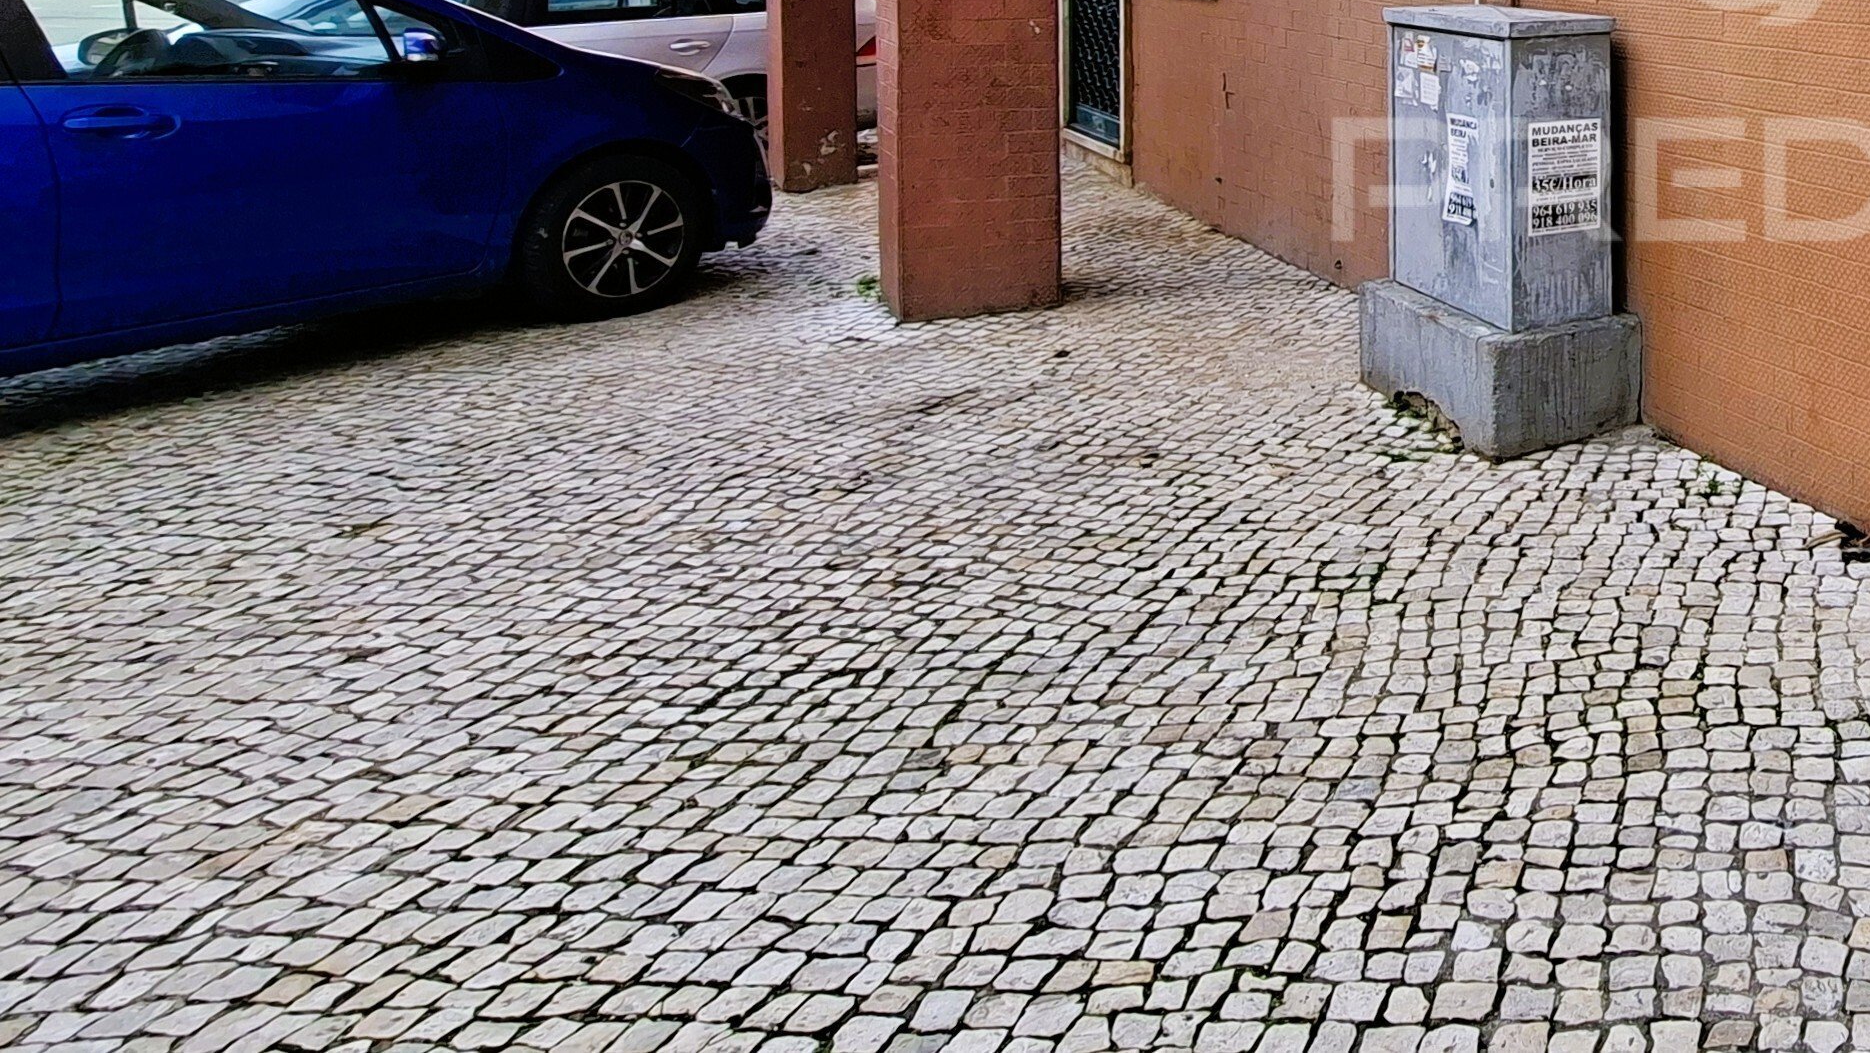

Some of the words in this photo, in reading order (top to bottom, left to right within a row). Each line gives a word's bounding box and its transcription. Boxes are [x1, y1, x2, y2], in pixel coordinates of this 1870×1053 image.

[1532, 122, 1598, 136] MUDANÇAS
[1532, 133, 1597, 148] BEIRA-MAR
[1534, 176, 1596, 193] 35€/Hora
[1533, 205, 1552, 217] 964
[1556, 202, 1575, 215] 619
[1578, 199, 1597, 212] 935
[1533, 217, 1553, 229] 918
[1556, 213, 1575, 226] 400
[1578, 211, 1597, 223] 096
